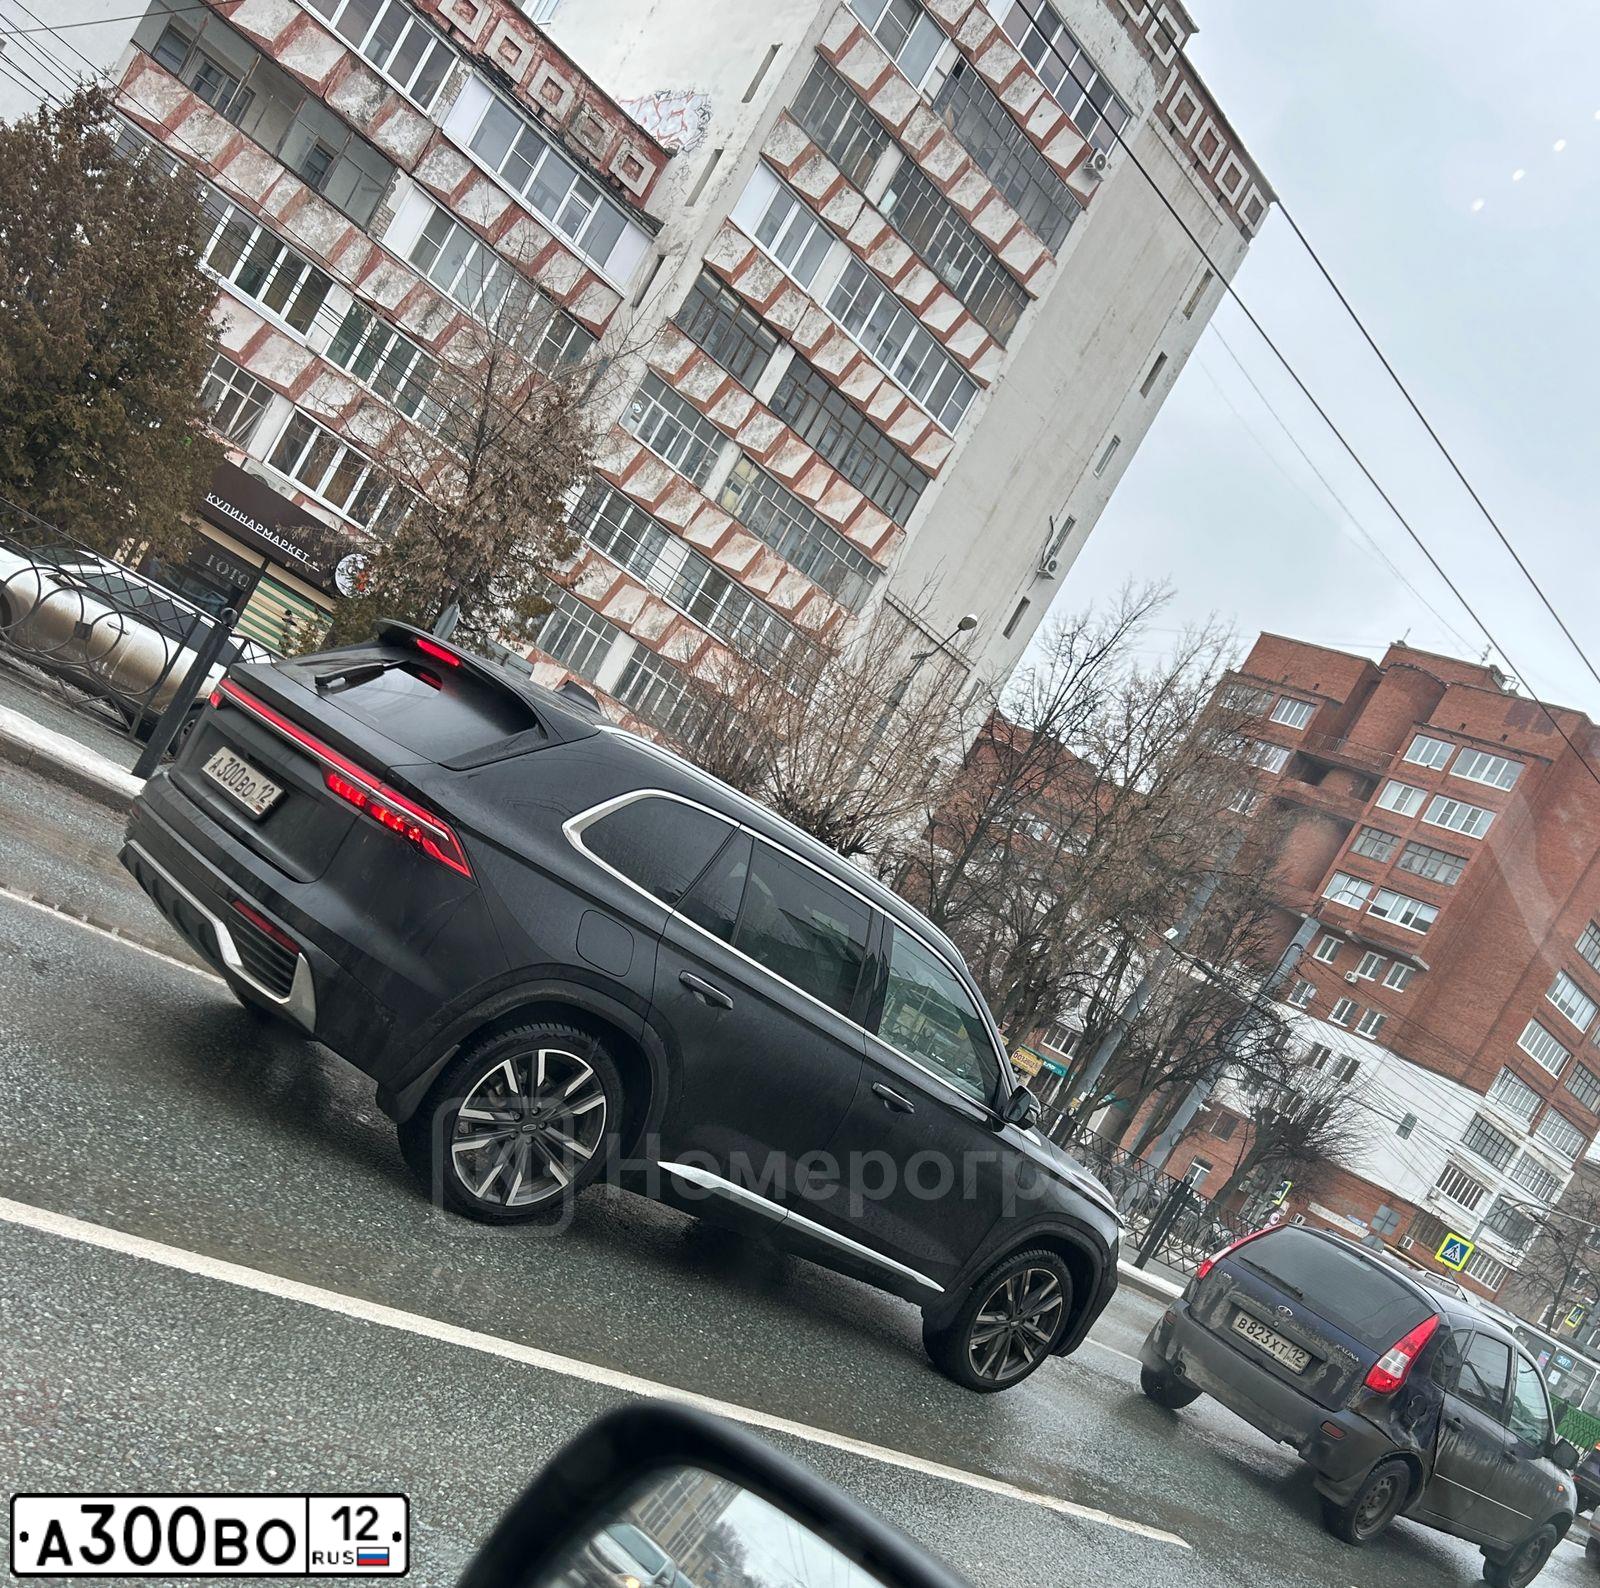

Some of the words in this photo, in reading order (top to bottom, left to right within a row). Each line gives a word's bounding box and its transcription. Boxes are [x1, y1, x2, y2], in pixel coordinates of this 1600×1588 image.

[206, 492, 310, 561] КУЛИНАРМАРКЕТ
[208, 757, 256, 798] А300ВО
[256, 784, 275, 803] 12
[1237, 1318, 1288, 1354] В823ХТ
[1292, 1348, 1305, 1363] 12
